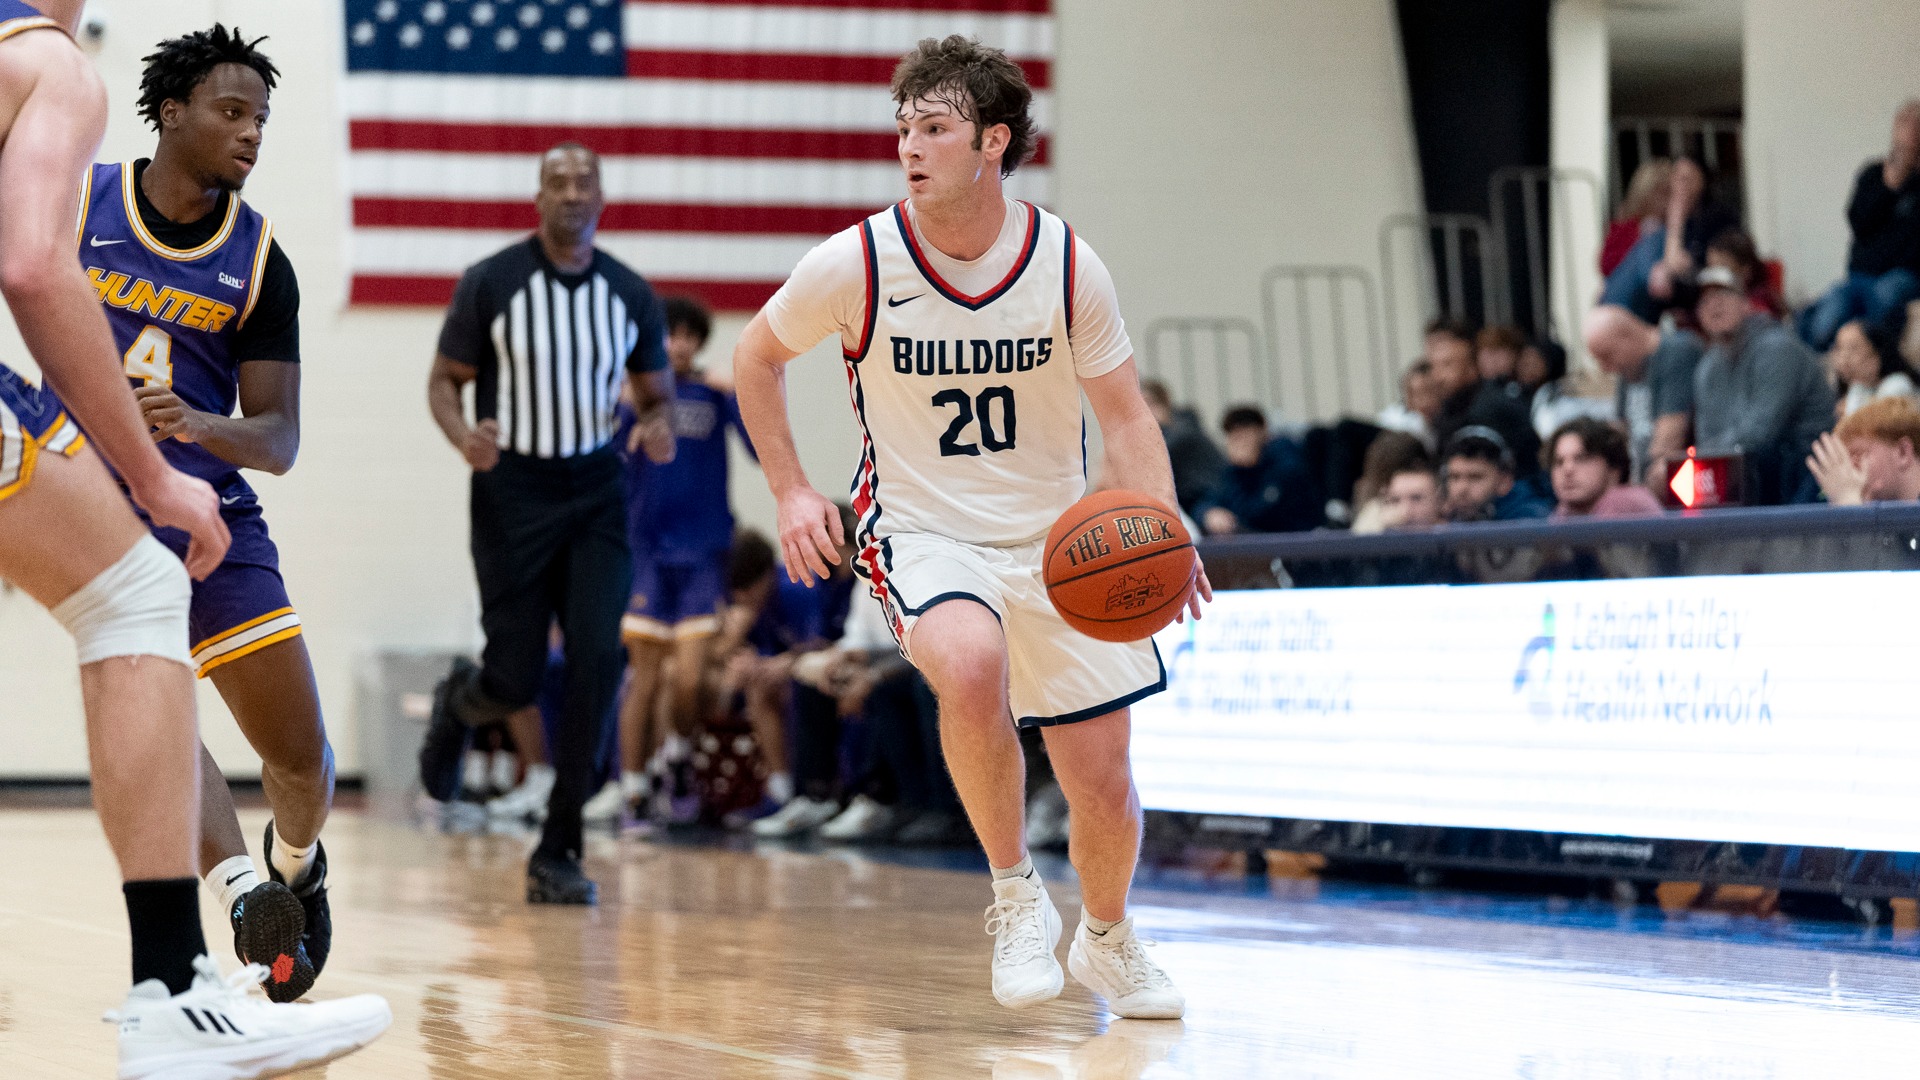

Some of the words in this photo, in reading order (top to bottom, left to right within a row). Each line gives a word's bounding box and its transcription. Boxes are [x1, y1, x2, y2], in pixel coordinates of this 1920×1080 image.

[86, 266, 236, 332] HUNTER
[218, 272, 245, 289] CUNY
[124, 324, 173, 389] 4
[890, 336, 1053, 375] BULLDOGS
[932, 385, 1016, 456] 20
[1065, 524, 1111, 567] THE
[1113, 516, 1174, 550] ROCK
[1105, 584, 1165, 613] ROCK
[1125, 600, 1146, 610] 2.0
[1571, 601, 1659, 664] Lehigh
[1667, 597, 1748, 664] Valley
[1563, 669, 1646, 722] Health
[1654, 669, 1774, 725] Network
